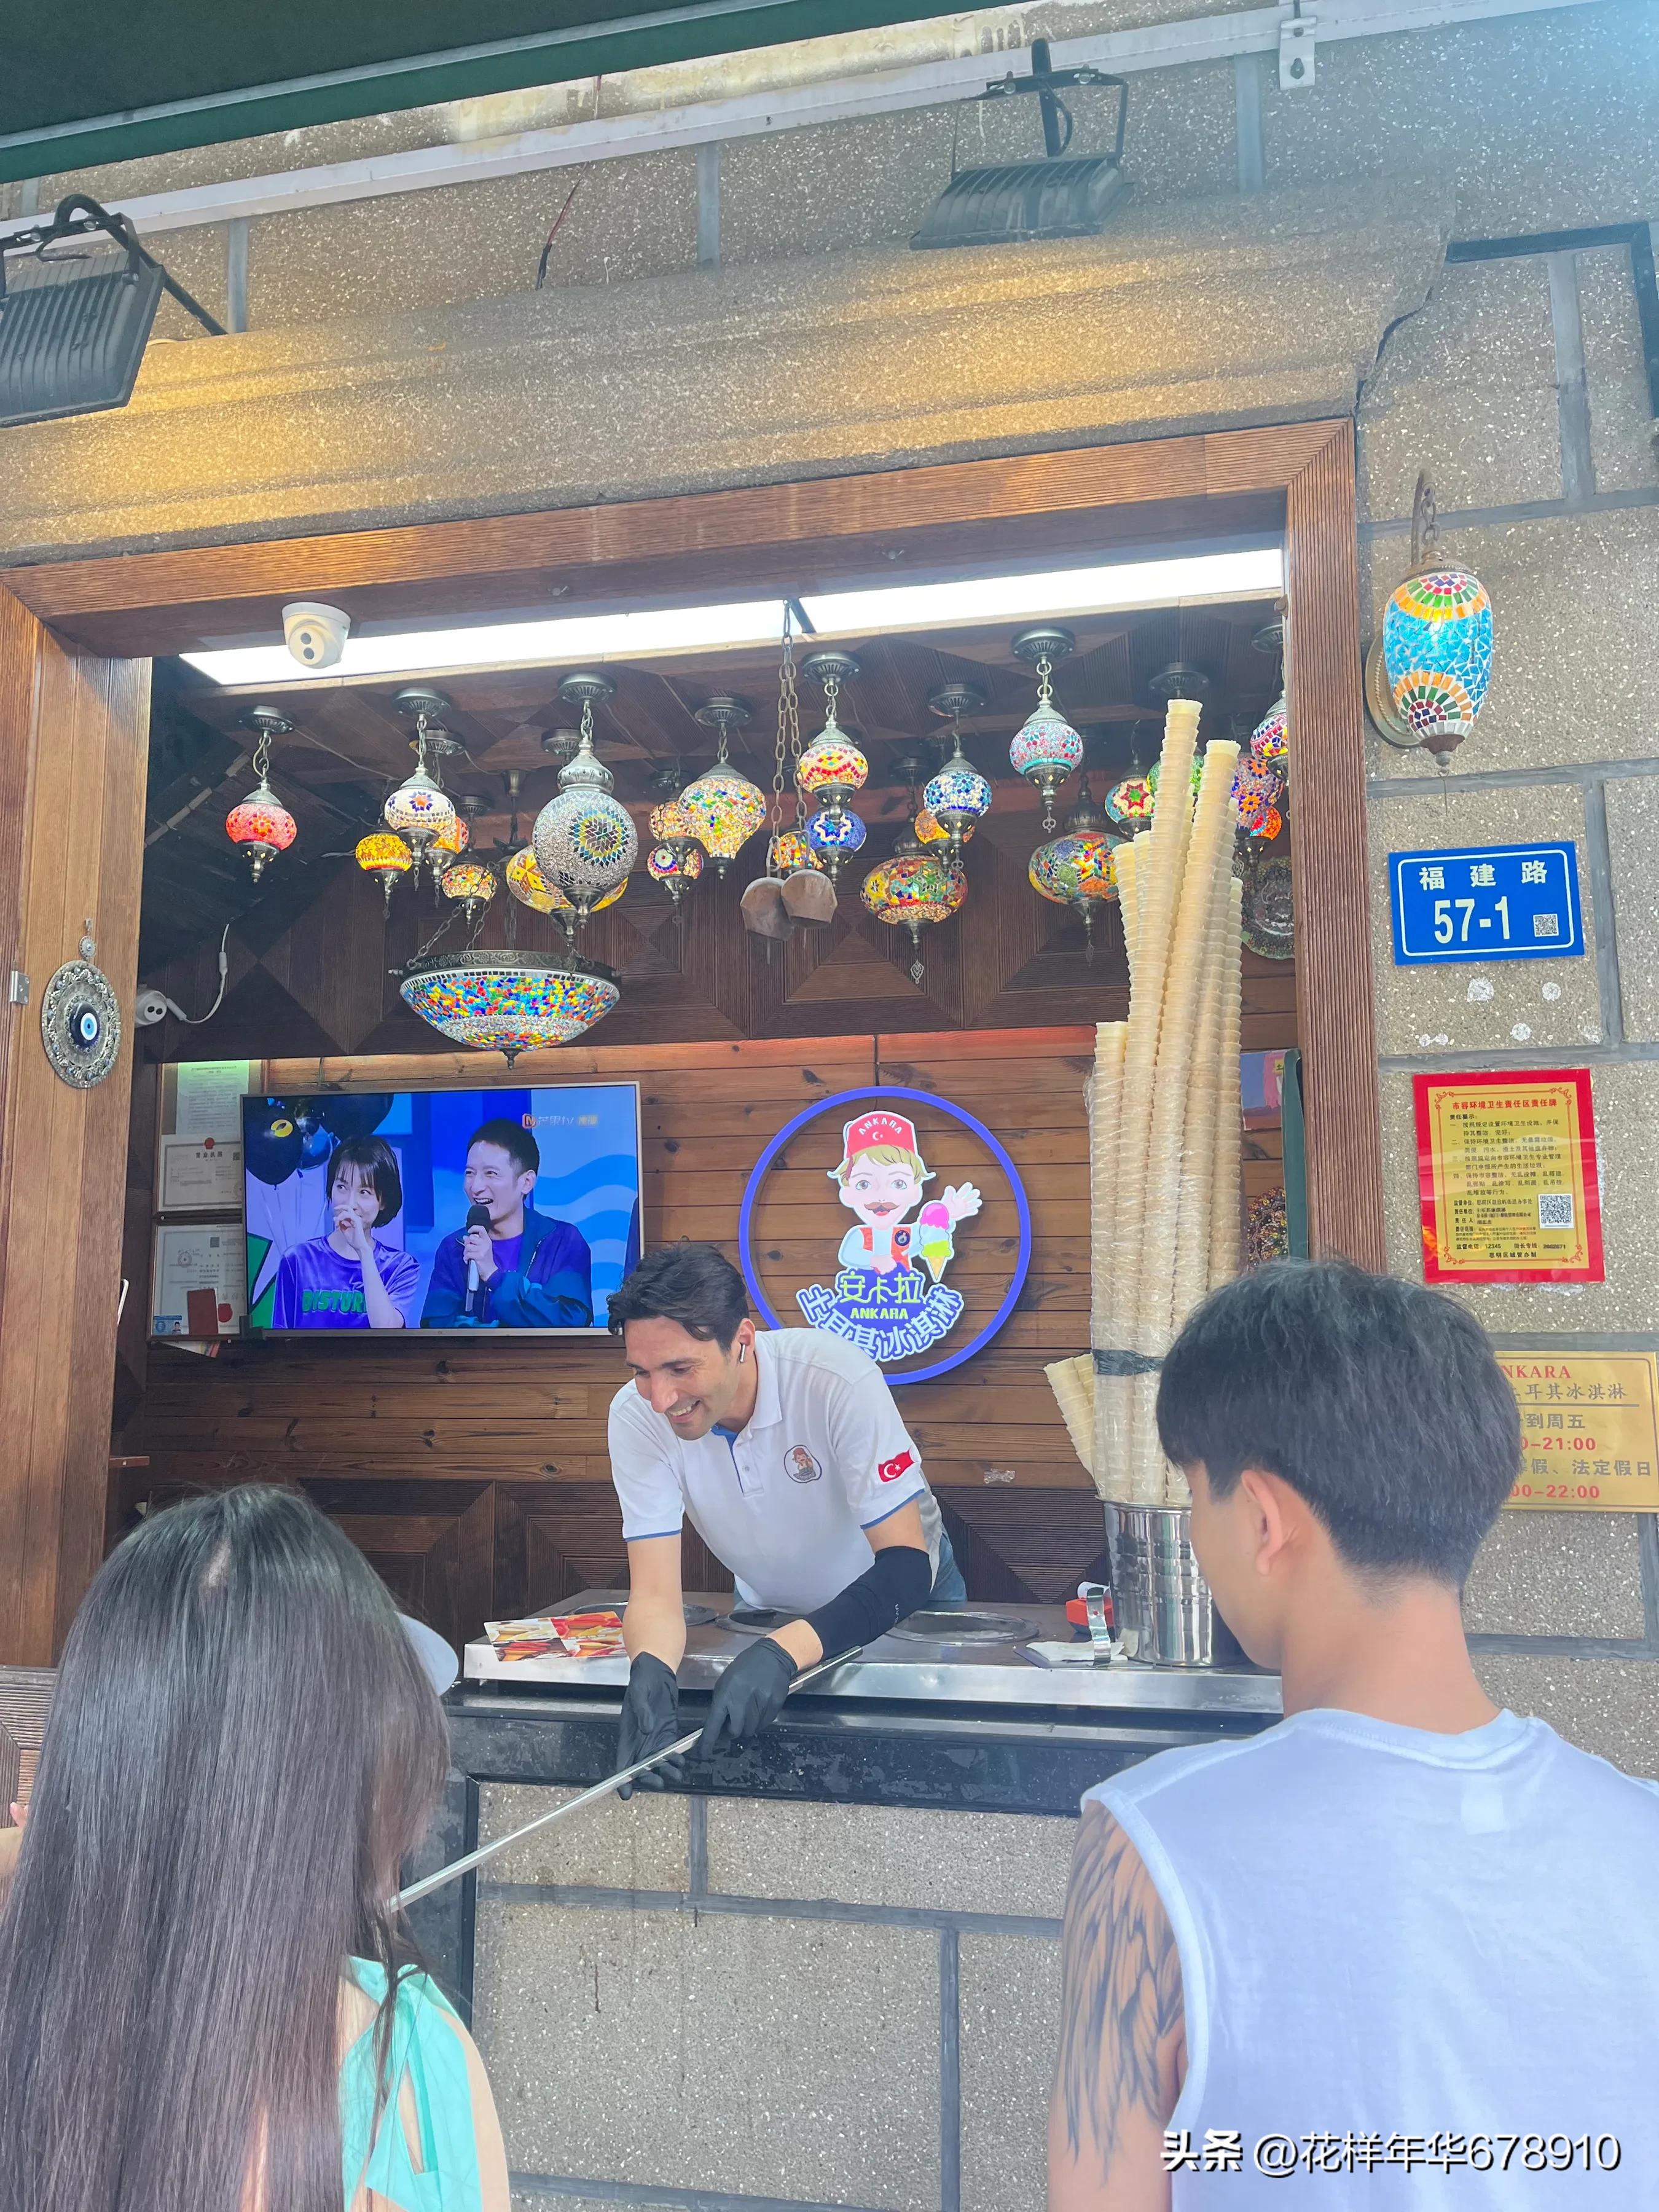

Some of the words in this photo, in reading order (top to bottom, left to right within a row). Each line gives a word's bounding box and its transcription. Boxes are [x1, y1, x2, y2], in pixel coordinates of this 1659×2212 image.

[1419, 860, 1548, 891] 福建路
[1433, 895, 1511, 944] 57-1
[1452, 1099, 1557, 1110] 市容环境卫生责任区责任牌
[858, 1117, 902, 1135] ANKARA
[839, 1271, 921, 1304] 安卡拉
[302, 1290, 367, 1314] DISTUR
[850, 1307, 909, 1319] ANKARA
[1521, 1413, 1586, 1429] 到周五
